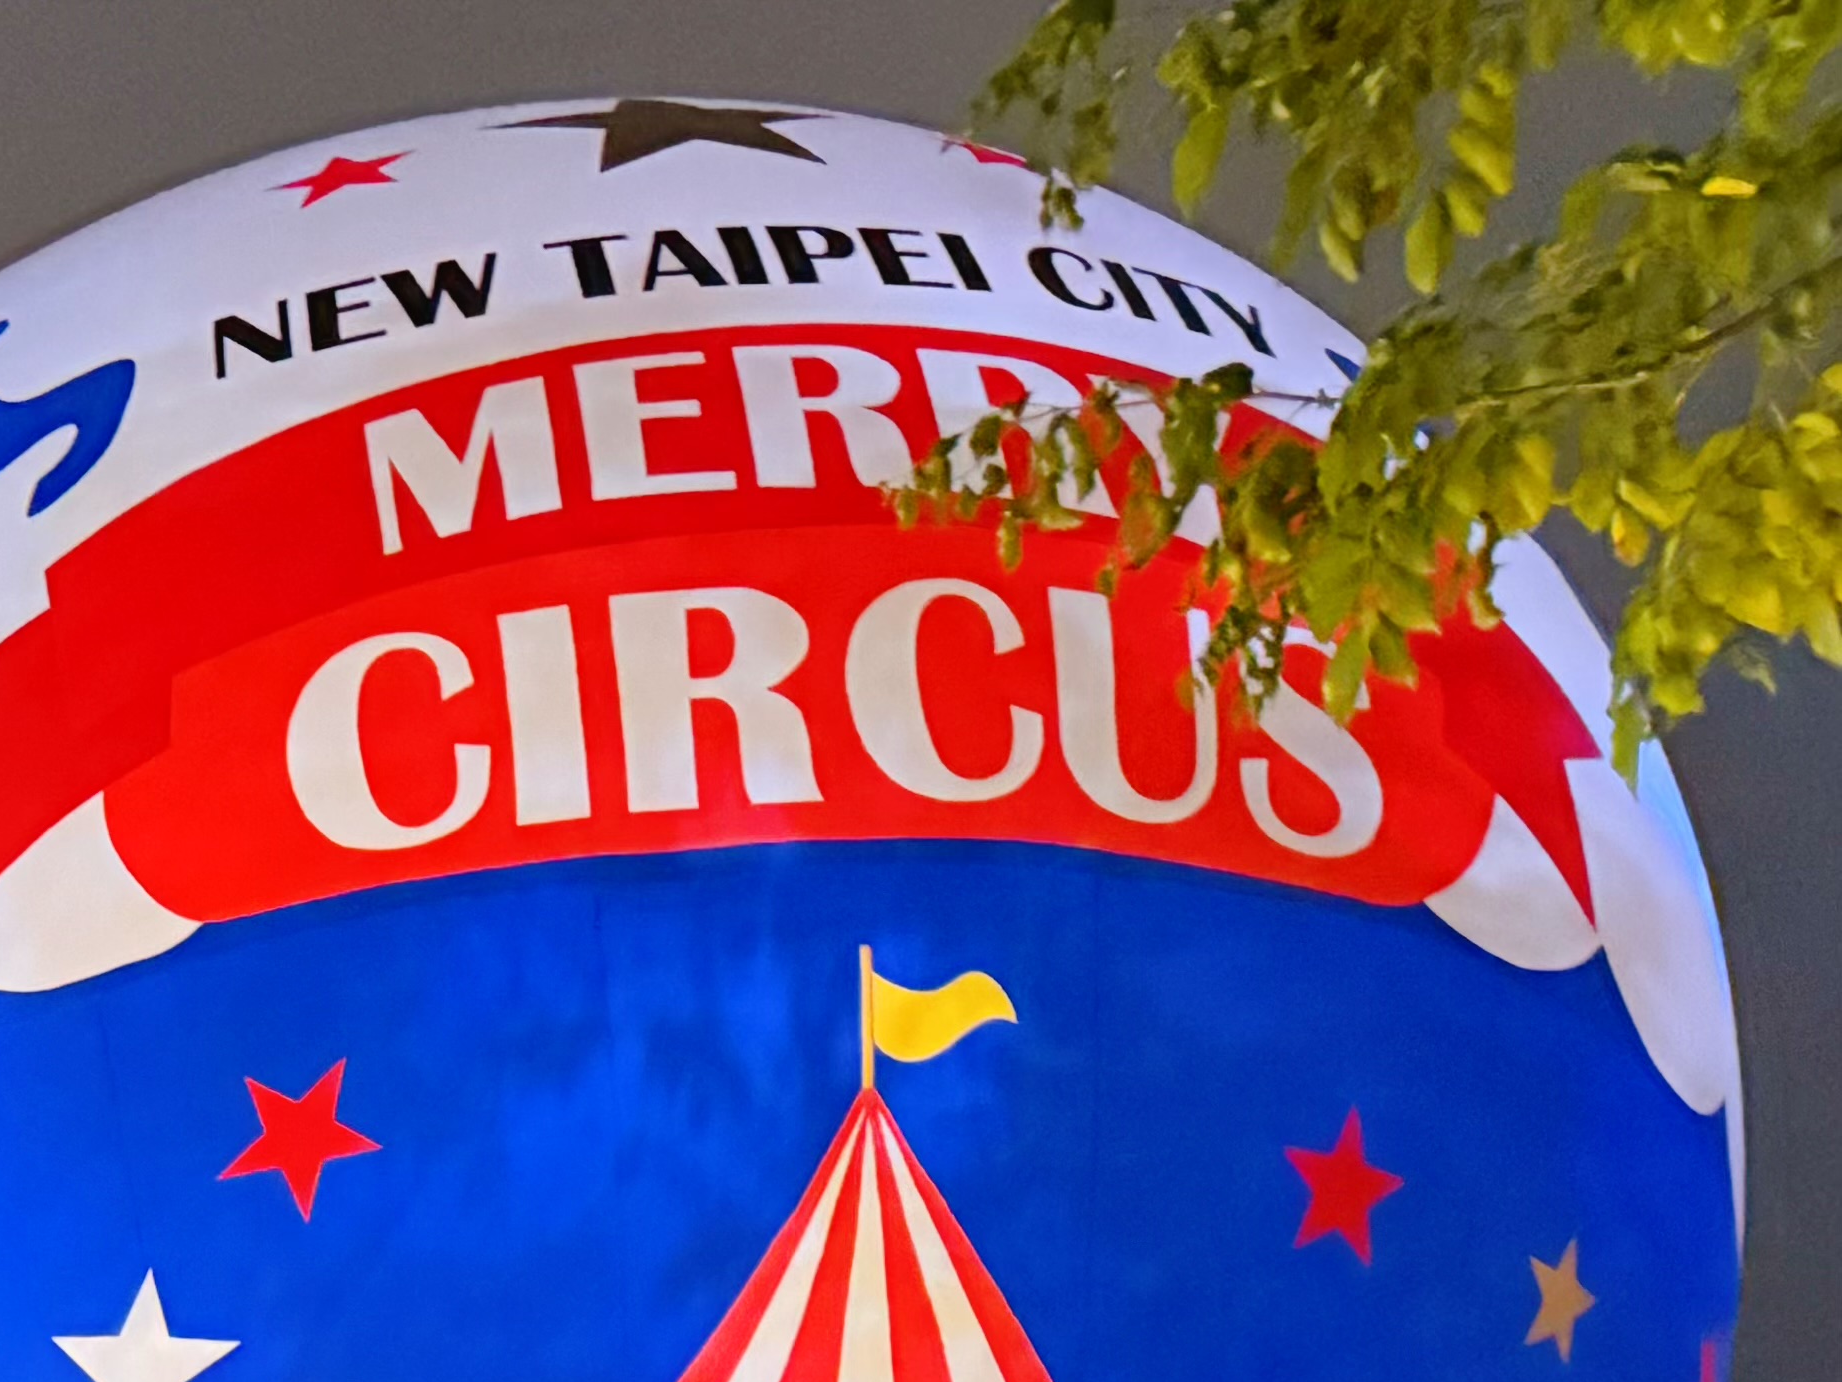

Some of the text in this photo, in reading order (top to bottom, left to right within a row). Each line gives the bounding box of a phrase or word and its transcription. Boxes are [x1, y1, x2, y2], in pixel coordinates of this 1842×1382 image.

[213, 223, 1278, 379] NEW TAIPEI CITY
[285, 576, 1384, 858] CIRCUS
